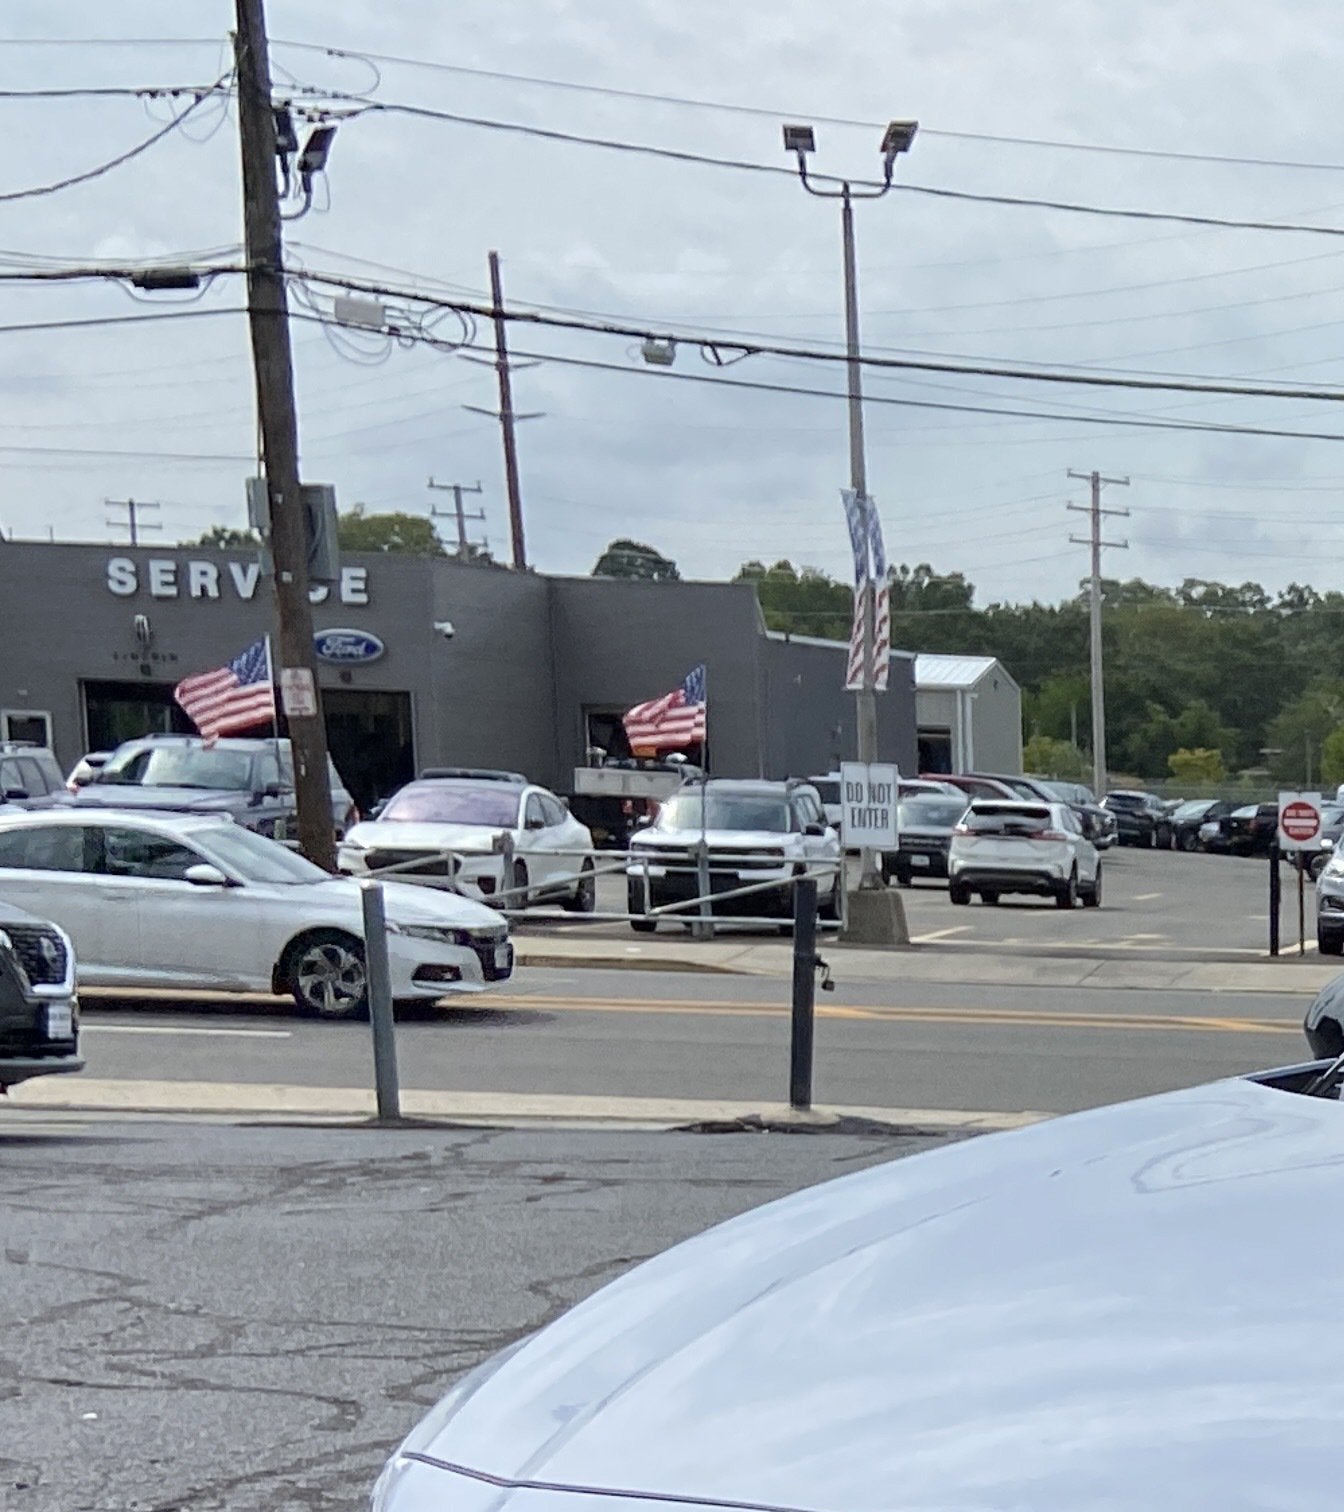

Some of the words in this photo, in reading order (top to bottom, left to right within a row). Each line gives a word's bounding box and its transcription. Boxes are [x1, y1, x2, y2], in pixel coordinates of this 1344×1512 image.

[107, 557, 369, 605] SERVE
[322, 635, 367, 657] Ford
[846, 782, 863, 803] DO
[868, 782, 892, 805] NOT
[852, 807, 889, 829] ENTER
